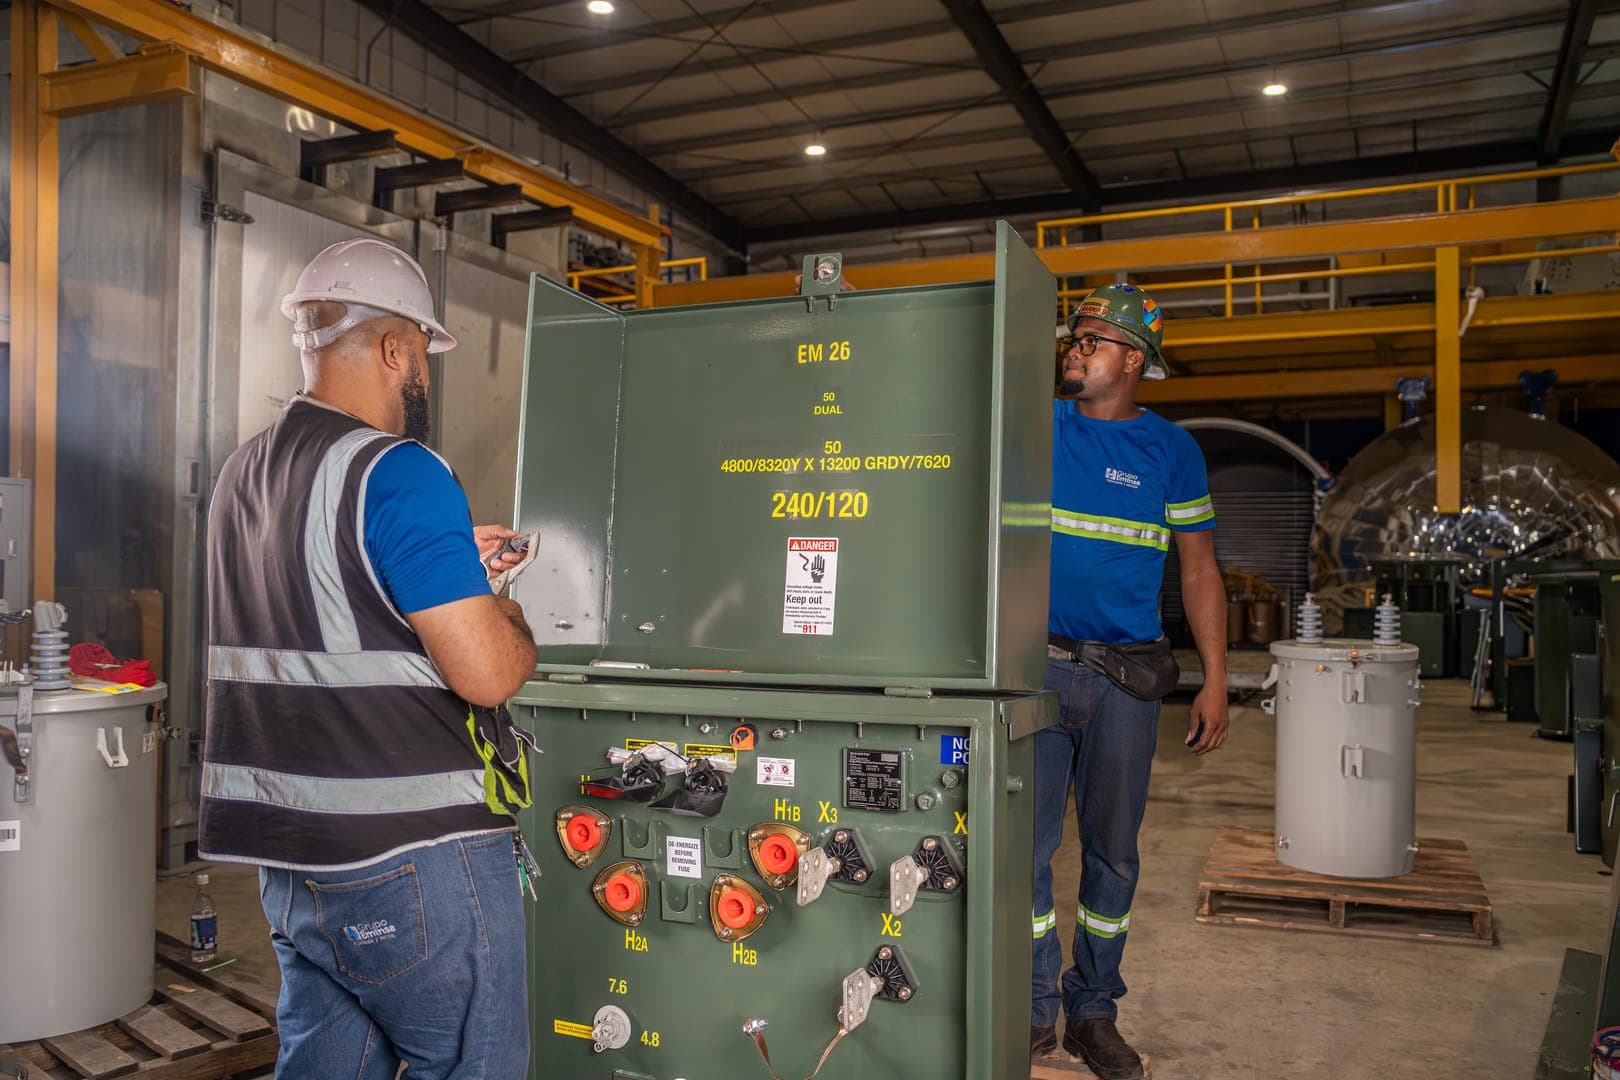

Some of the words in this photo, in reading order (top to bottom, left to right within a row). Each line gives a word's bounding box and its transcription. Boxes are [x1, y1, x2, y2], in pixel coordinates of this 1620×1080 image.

[797, 343, 823, 364] EM
[829, 340, 852, 362] 26
[823, 392, 836, 402] 50
[814, 405, 843, 415] DUAL
[824, 440, 842, 455] 50
[720, 458, 800, 473] 4800/8320Y
[804, 458, 814, 472] X
[819, 457, 861, 472] 13200
[864, 454, 951, 471] GRDY/7620
[771, 491, 869, 518] 240/120
[801, 541, 836, 551] DANGER
[786, 594, 807, 606] Keep
[808, 595, 823, 605] out
[802, 624, 817, 634] 911
[774, 799, 801, 822] H1B
[818, 800, 839, 824] X3
[672, 857, 697, 866] REMOVING
[357, 919, 388, 931] Grupo
[881, 913, 902, 937] X2
[625, 929, 649, 952] H2A
[732, 941, 759, 966] H2B
[608, 978, 628, 994] 7.6
[640, 1030, 660, 1047] 4.8
